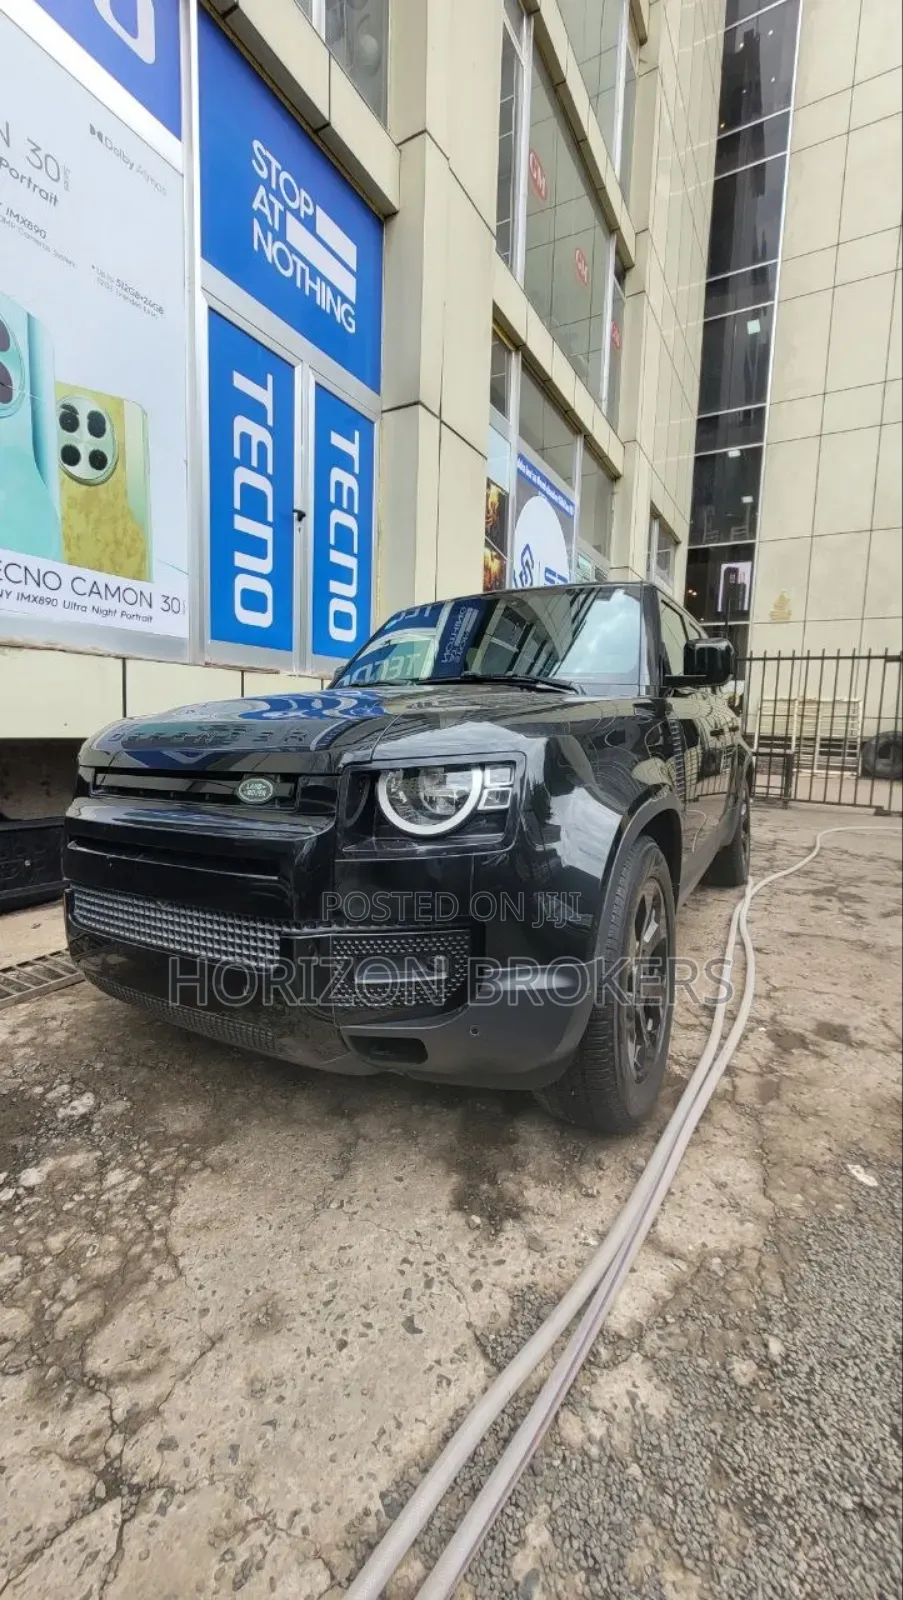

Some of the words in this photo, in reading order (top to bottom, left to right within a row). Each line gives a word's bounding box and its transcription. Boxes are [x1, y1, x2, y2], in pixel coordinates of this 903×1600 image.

[25, 136, 61, 183] 30
[104, 136, 134, 170] Dolby
[0, 155, 58, 206] Portrait
[251, 139, 315, 219] STOP
[6, 207, 47, 239] IMX890
[251, 184, 285, 231] AT
[252, 218, 356, 334] NOTHING
[232, 370, 274, 629] TECNO
[328, 430, 360, 643] TECNO
[16, 591, 58, 607] IMX890
[63, 599, 87, 613] Ultra
[91, 605, 117, 618] Night
[120, 610, 153, 623] Portrait
[71, 576, 153, 609] CAMON
[160, 594, 181, 615] 30
